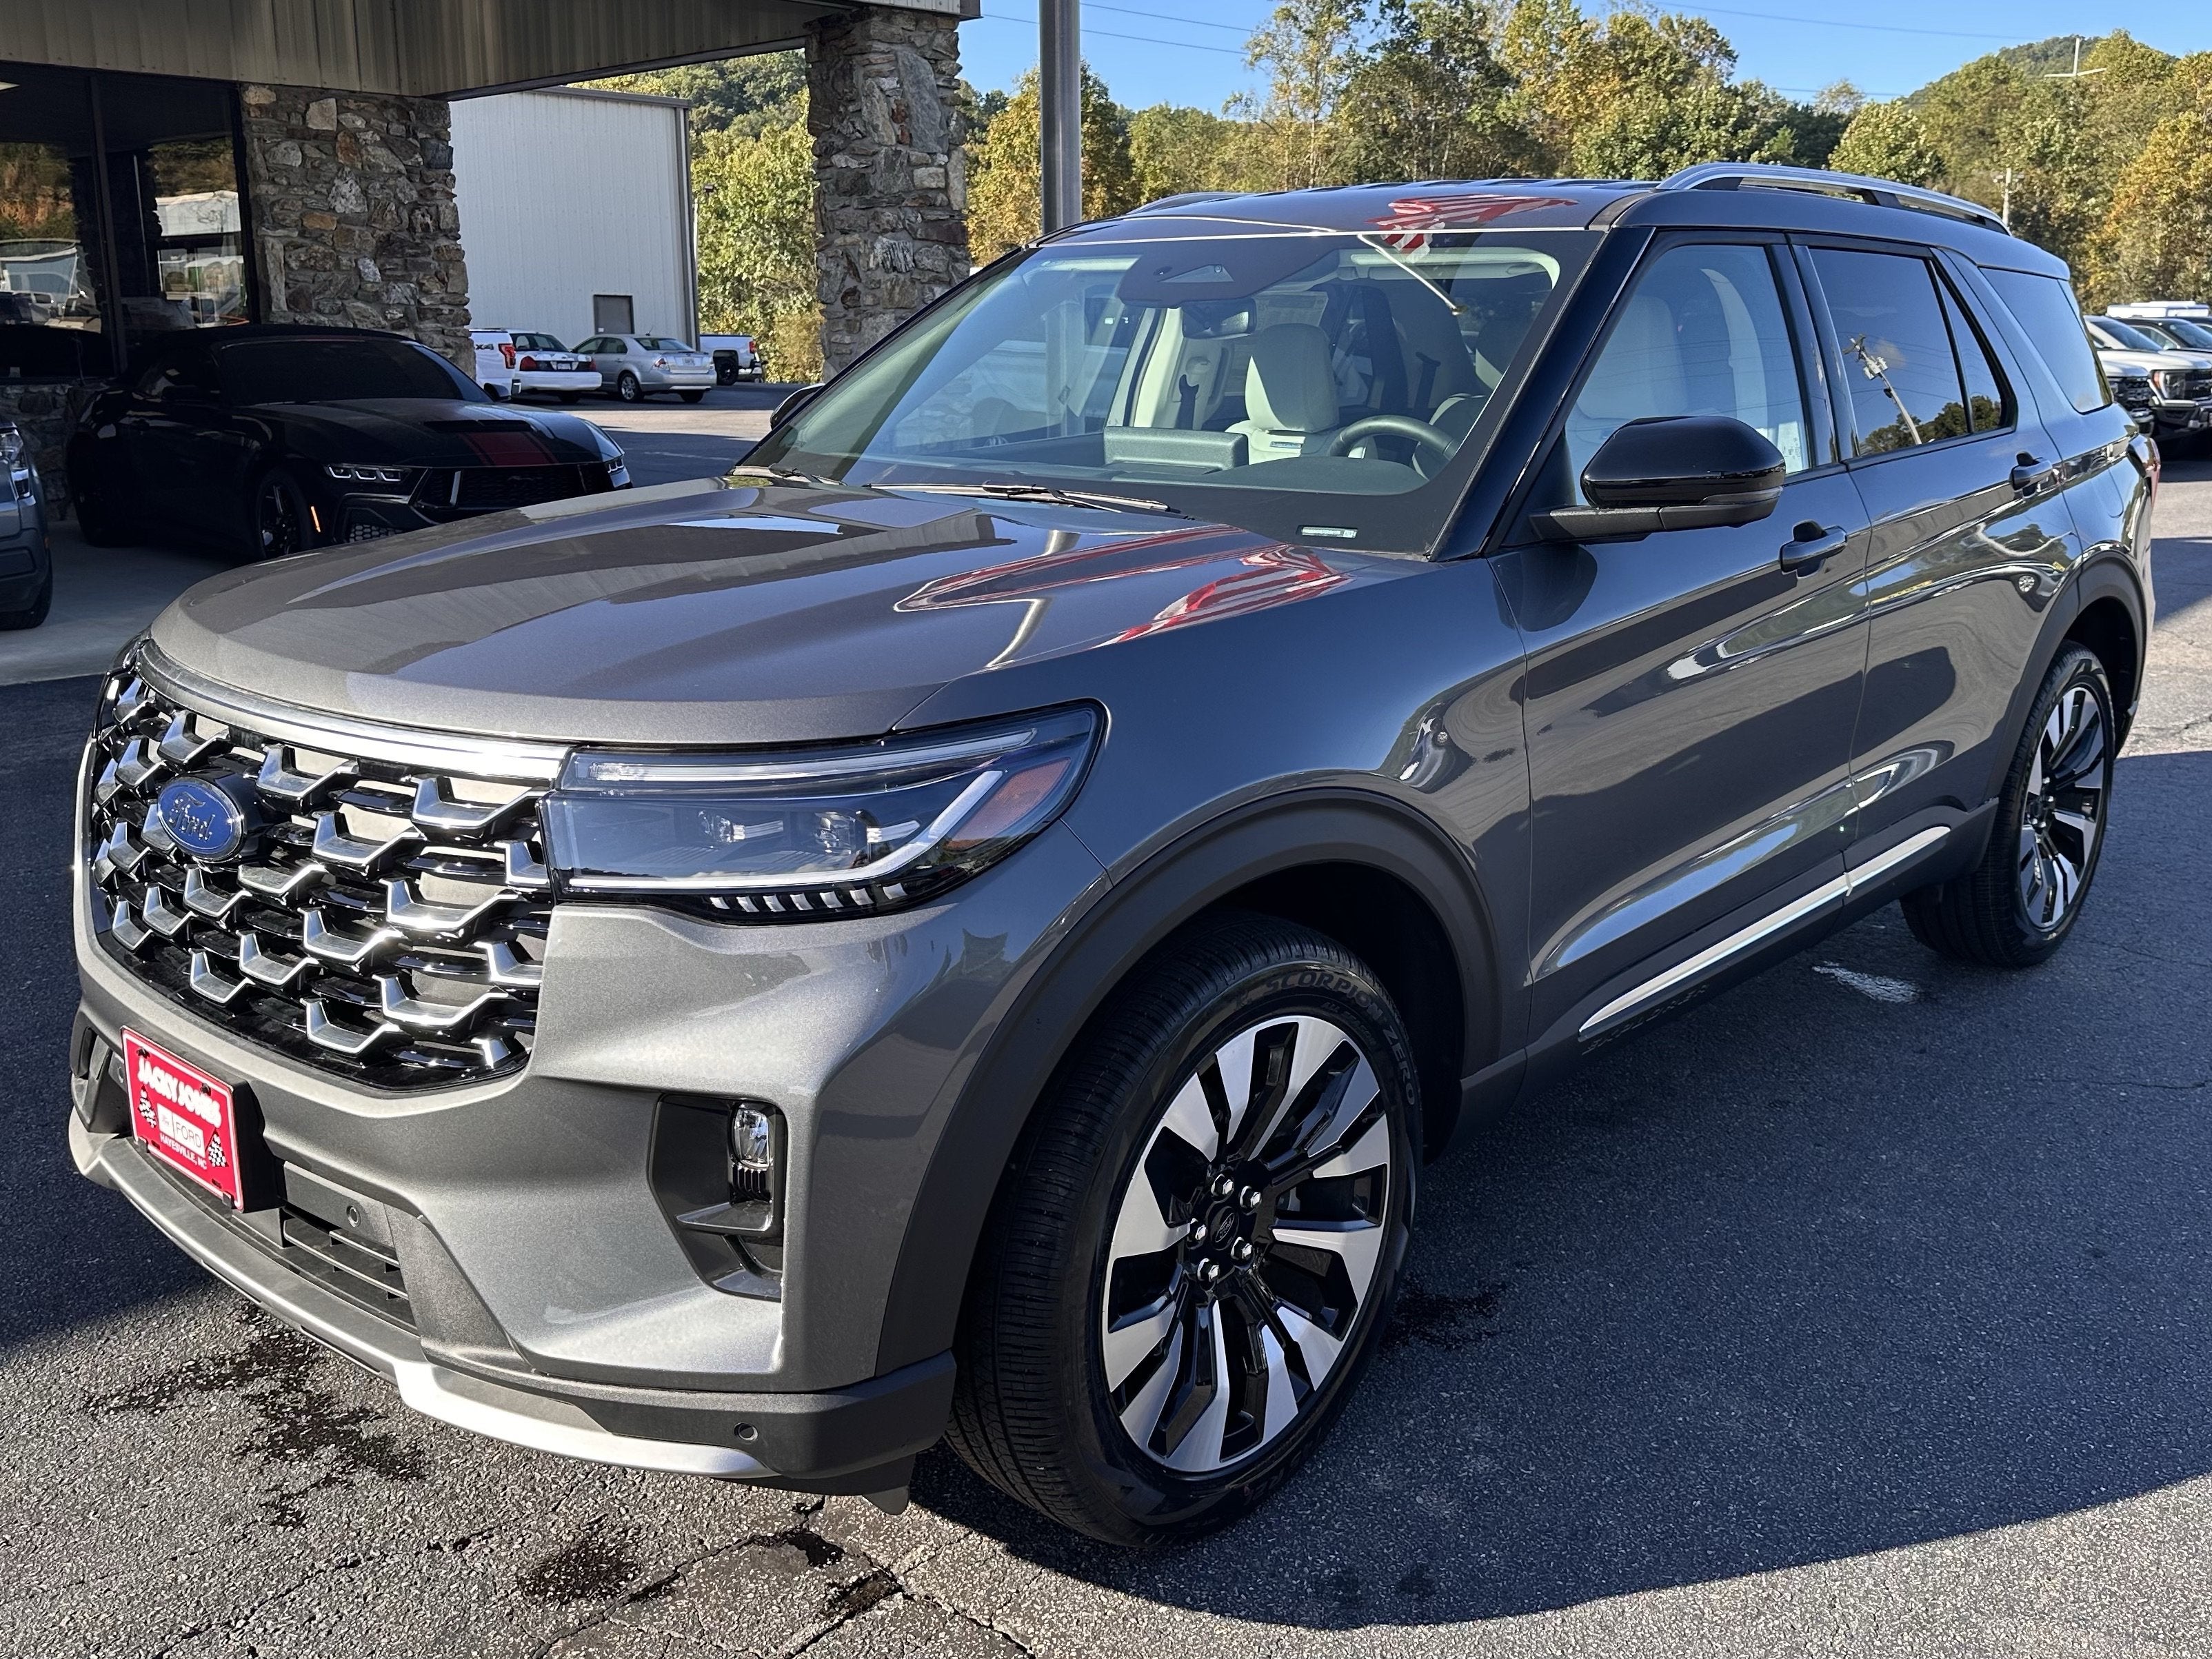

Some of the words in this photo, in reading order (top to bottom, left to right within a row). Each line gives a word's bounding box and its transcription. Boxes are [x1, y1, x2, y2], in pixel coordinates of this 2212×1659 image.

[168, 791, 217, 843] Ford
[1265, 971, 1384, 1021] SCORPION
[1382, 1025, 1416, 1106] ZERO
[137, 1055, 179, 1103] JACKY
[175, 1121, 201, 1148] FORD
